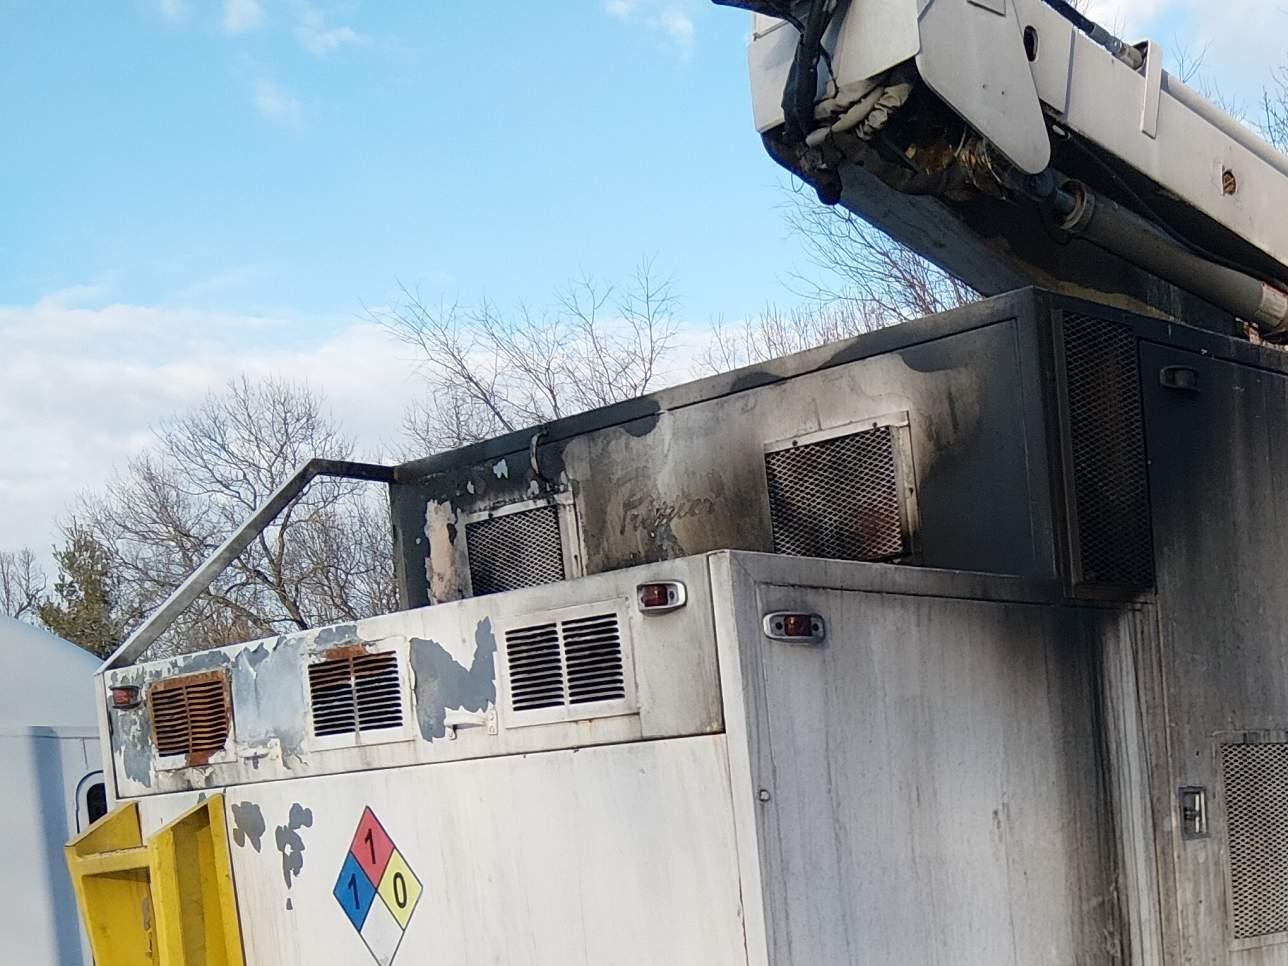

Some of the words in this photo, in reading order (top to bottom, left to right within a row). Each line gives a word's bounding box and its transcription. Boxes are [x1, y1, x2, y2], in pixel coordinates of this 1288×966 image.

[364, 828, 376, 864] 1
[348, 873, 361, 909] 1
[392, 871, 407, 909] 0
